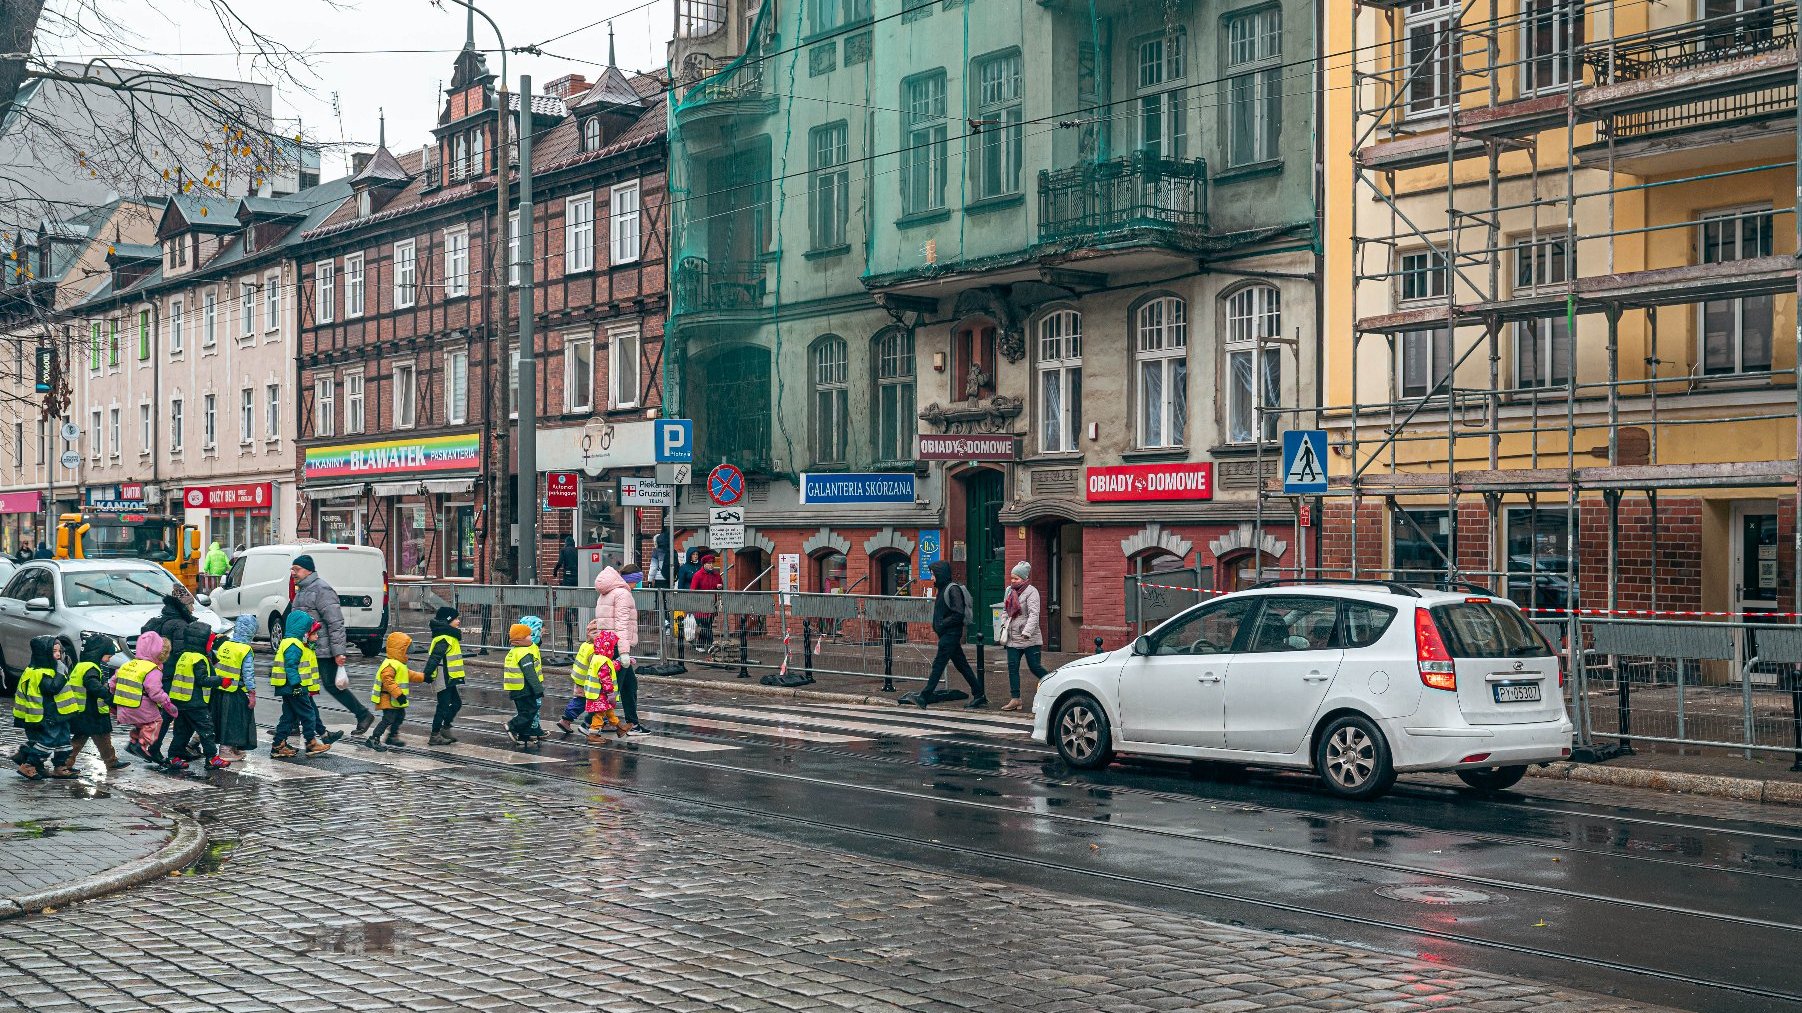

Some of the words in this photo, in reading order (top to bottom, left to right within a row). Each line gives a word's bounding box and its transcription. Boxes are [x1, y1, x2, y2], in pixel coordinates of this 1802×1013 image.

[663, 424, 685, 456] P
[920, 440, 958, 453] OBIADY
[967, 440, 1012, 453] DOMOWE
[311, 458, 344, 470] TKANINY
[350, 445, 427, 471] BŁAWATEK
[430, 448, 475, 461] PASMANTERIA
[807, 481, 863, 497] GALANTERIA
[865, 478, 912, 495] SKÓRZANA
[1089, 474, 1134, 493] OBIADY
[1147, 471, 1206, 491] DOMOWE
[123, 487, 140, 499] KANTOR
[209, 489, 224, 503] DUŻY
[225, 490, 236, 503] BEN
[638, 489, 671, 497] Gruzińsk
